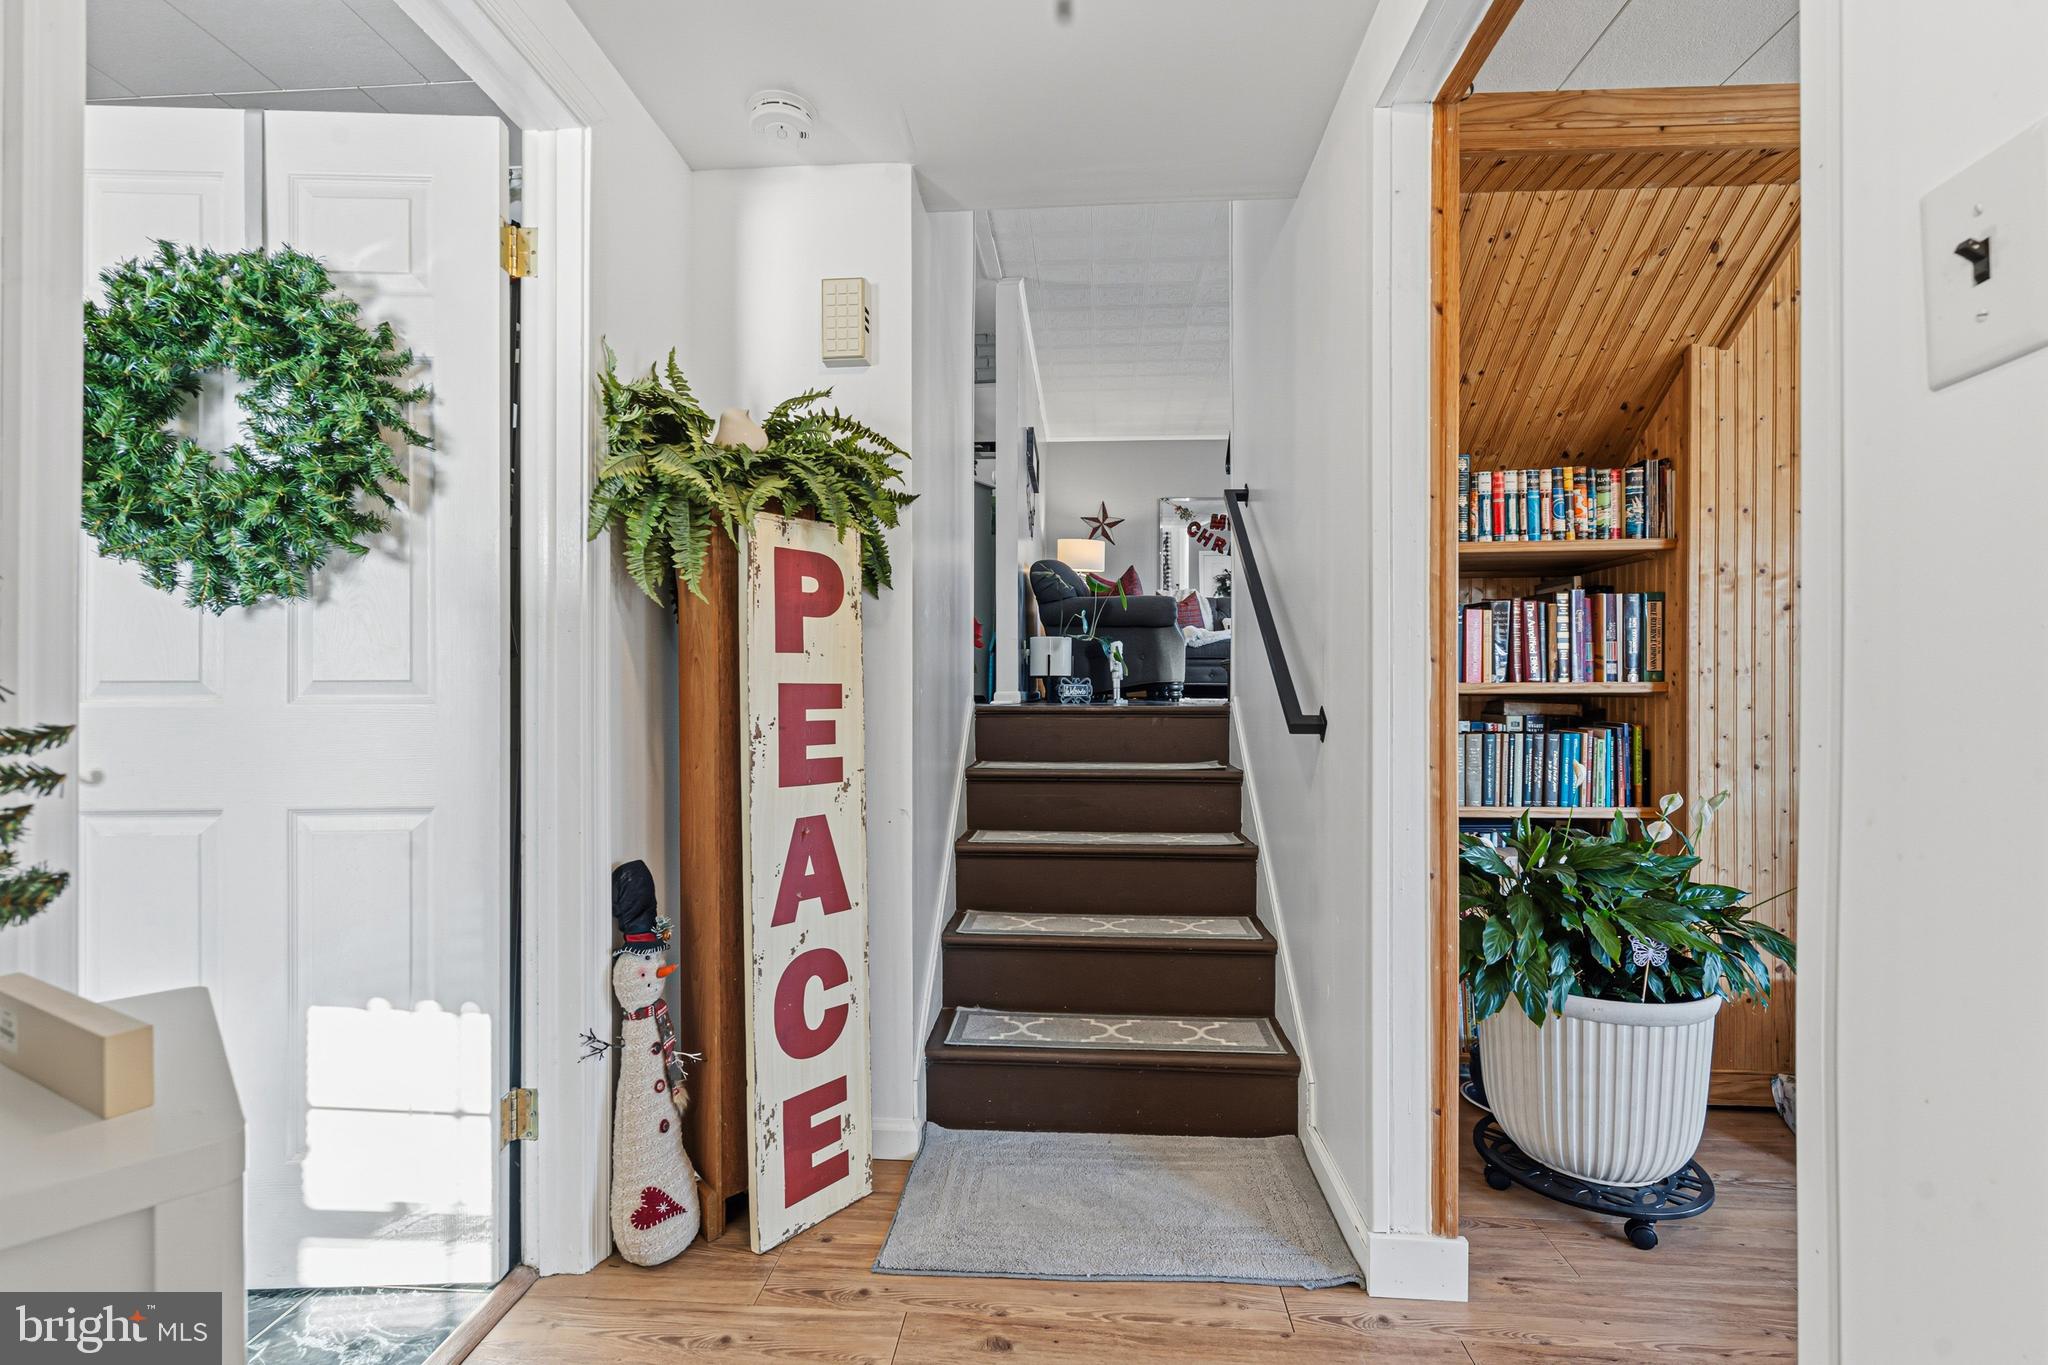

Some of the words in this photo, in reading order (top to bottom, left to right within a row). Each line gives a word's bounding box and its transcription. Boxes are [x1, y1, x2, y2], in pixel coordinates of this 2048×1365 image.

[1526, 602, 1535, 617] The
[1527, 620, 1537, 654] Amplified
[1530, 656, 1539, 673] Bible
[771, 546, 852, 1209] PEACE
